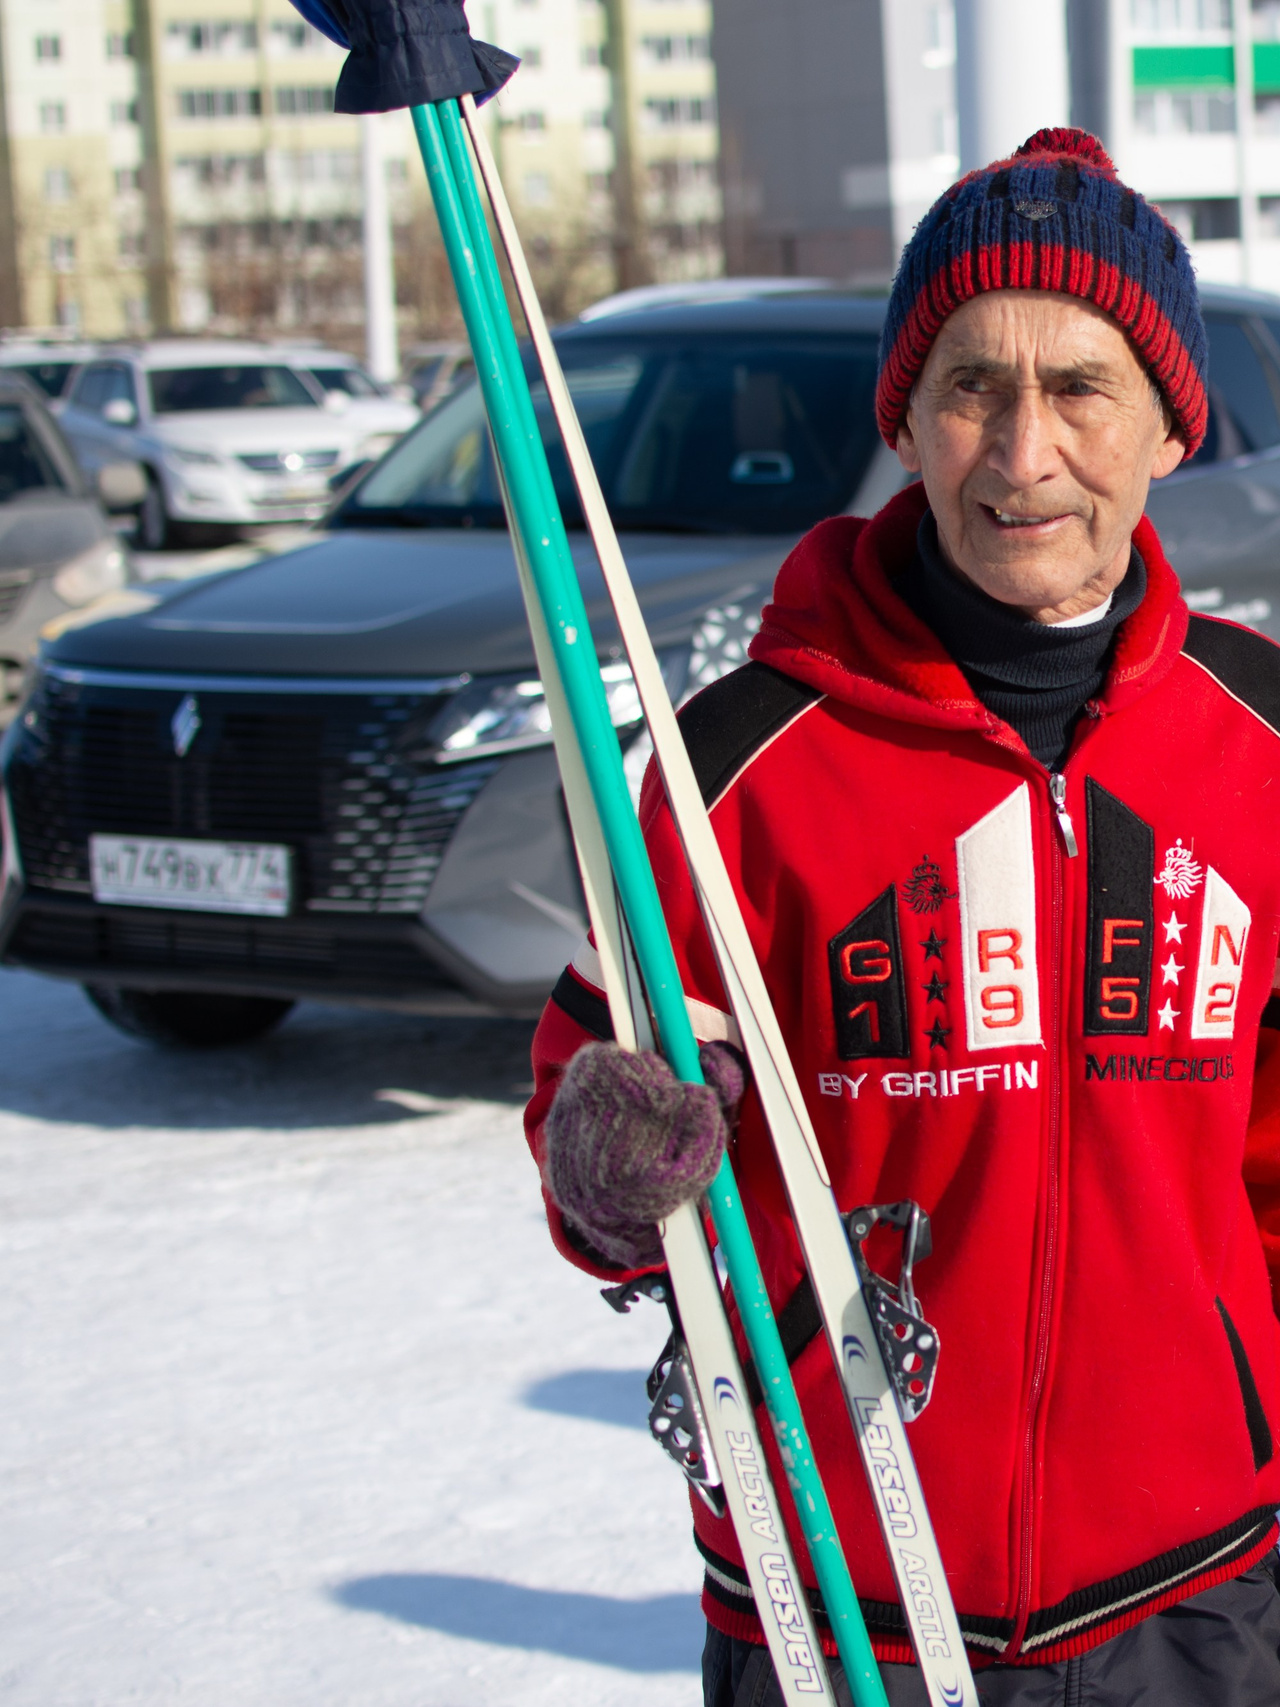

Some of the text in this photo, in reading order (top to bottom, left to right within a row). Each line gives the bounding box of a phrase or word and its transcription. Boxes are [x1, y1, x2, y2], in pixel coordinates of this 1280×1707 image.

[818, 1060, 1038, 1099] BY GRIFFIN
[726, 1430, 778, 1543] ARCTIC
[899, 1548, 951, 1658] ARCTIC
